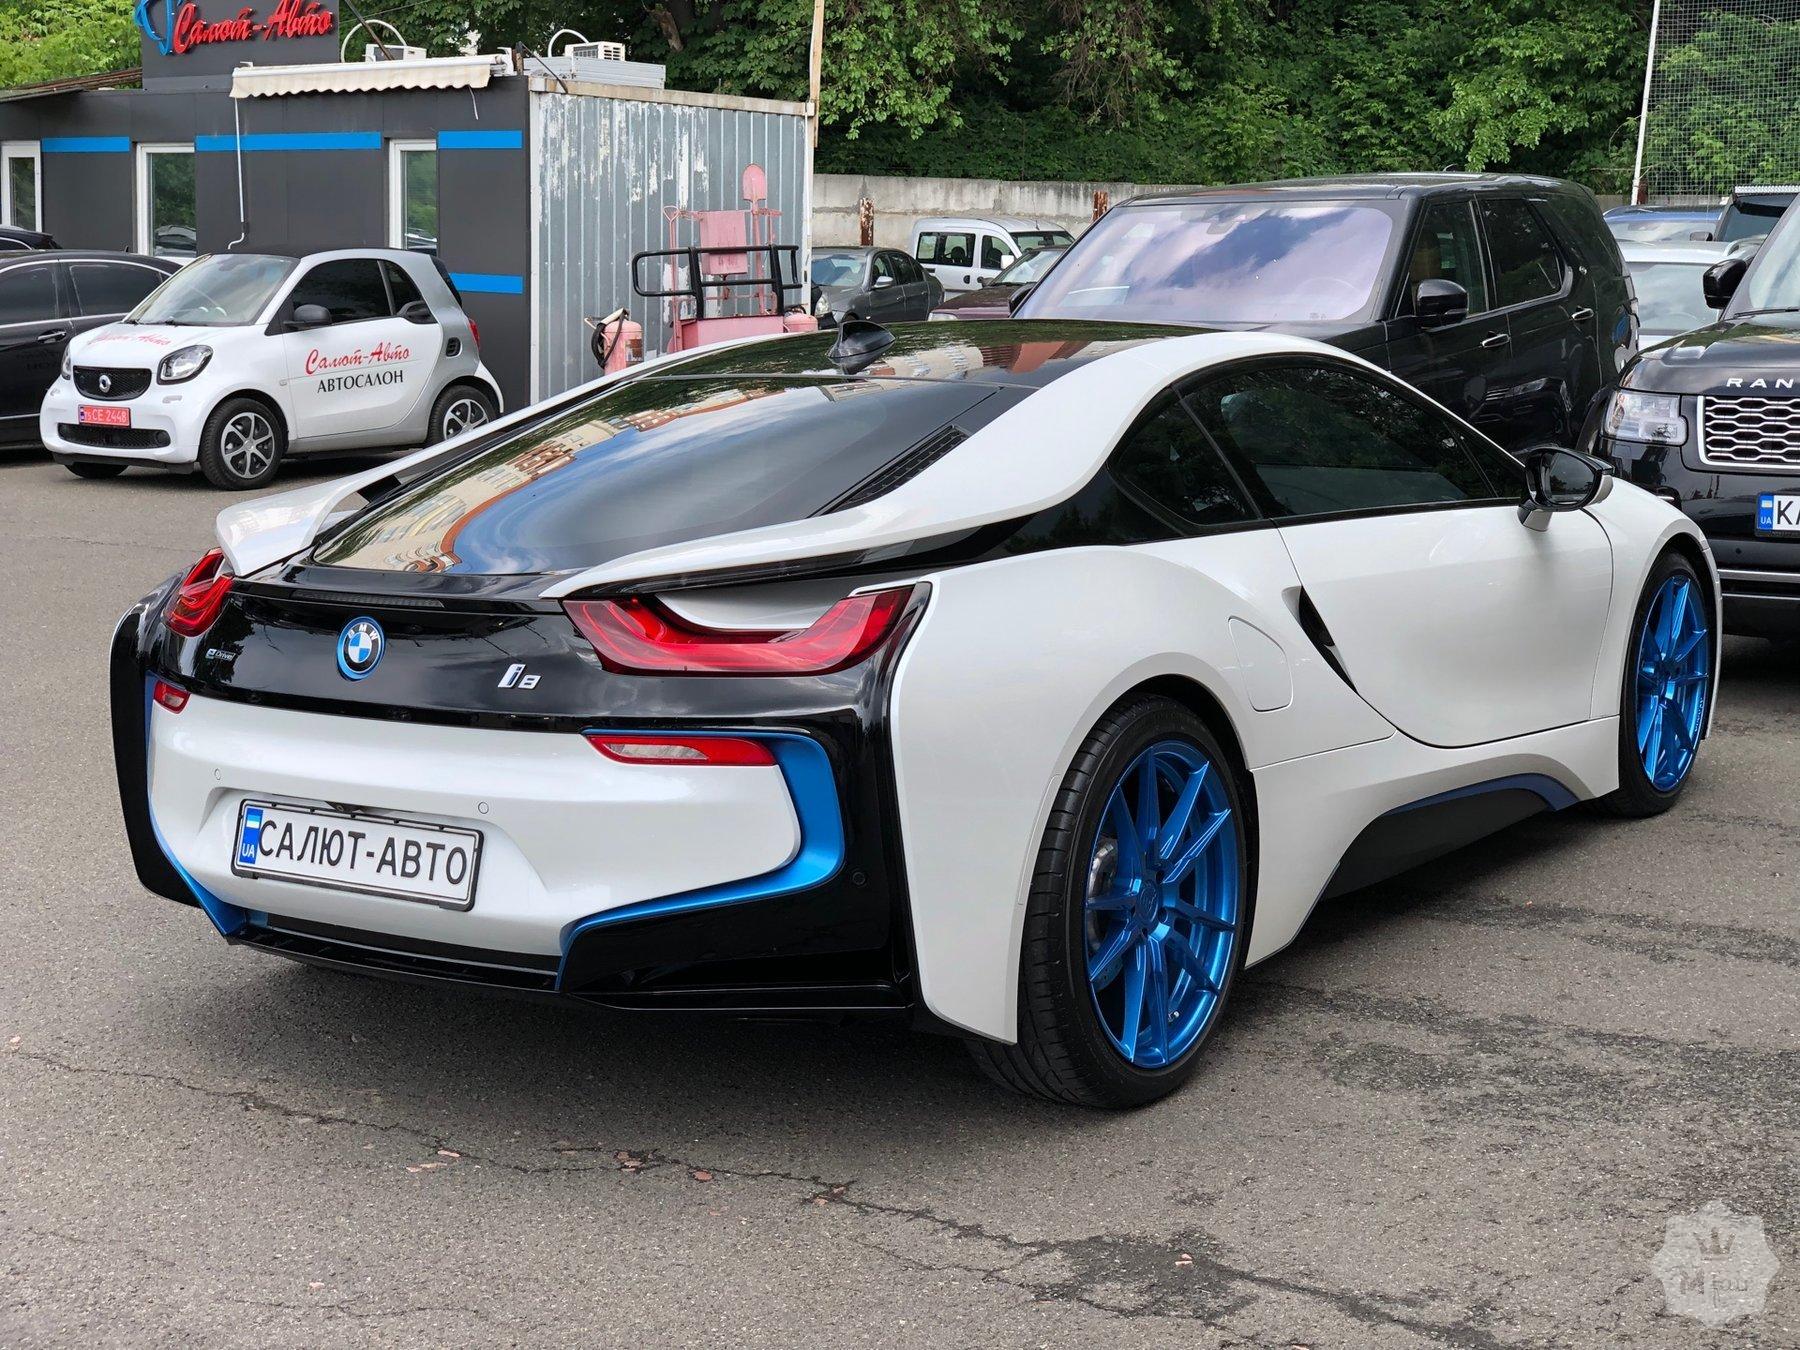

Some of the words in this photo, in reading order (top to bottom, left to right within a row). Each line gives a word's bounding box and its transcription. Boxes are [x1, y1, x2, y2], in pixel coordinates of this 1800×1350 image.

[173, 0, 332, 54] Салют-Авто
[305, 342, 410, 375] Салют-Авто
[317, 370, 403, 393] АВТОСАЛОН
[1760, 516, 1772, 525] UA
[1777, 500, 1800, 525] K
[348, 623, 378, 640] BMW
[497, 663, 542, 689] i8
[242, 843, 256, 858] UA
[259, 820, 467, 885] САЛЮТ-АВТО
